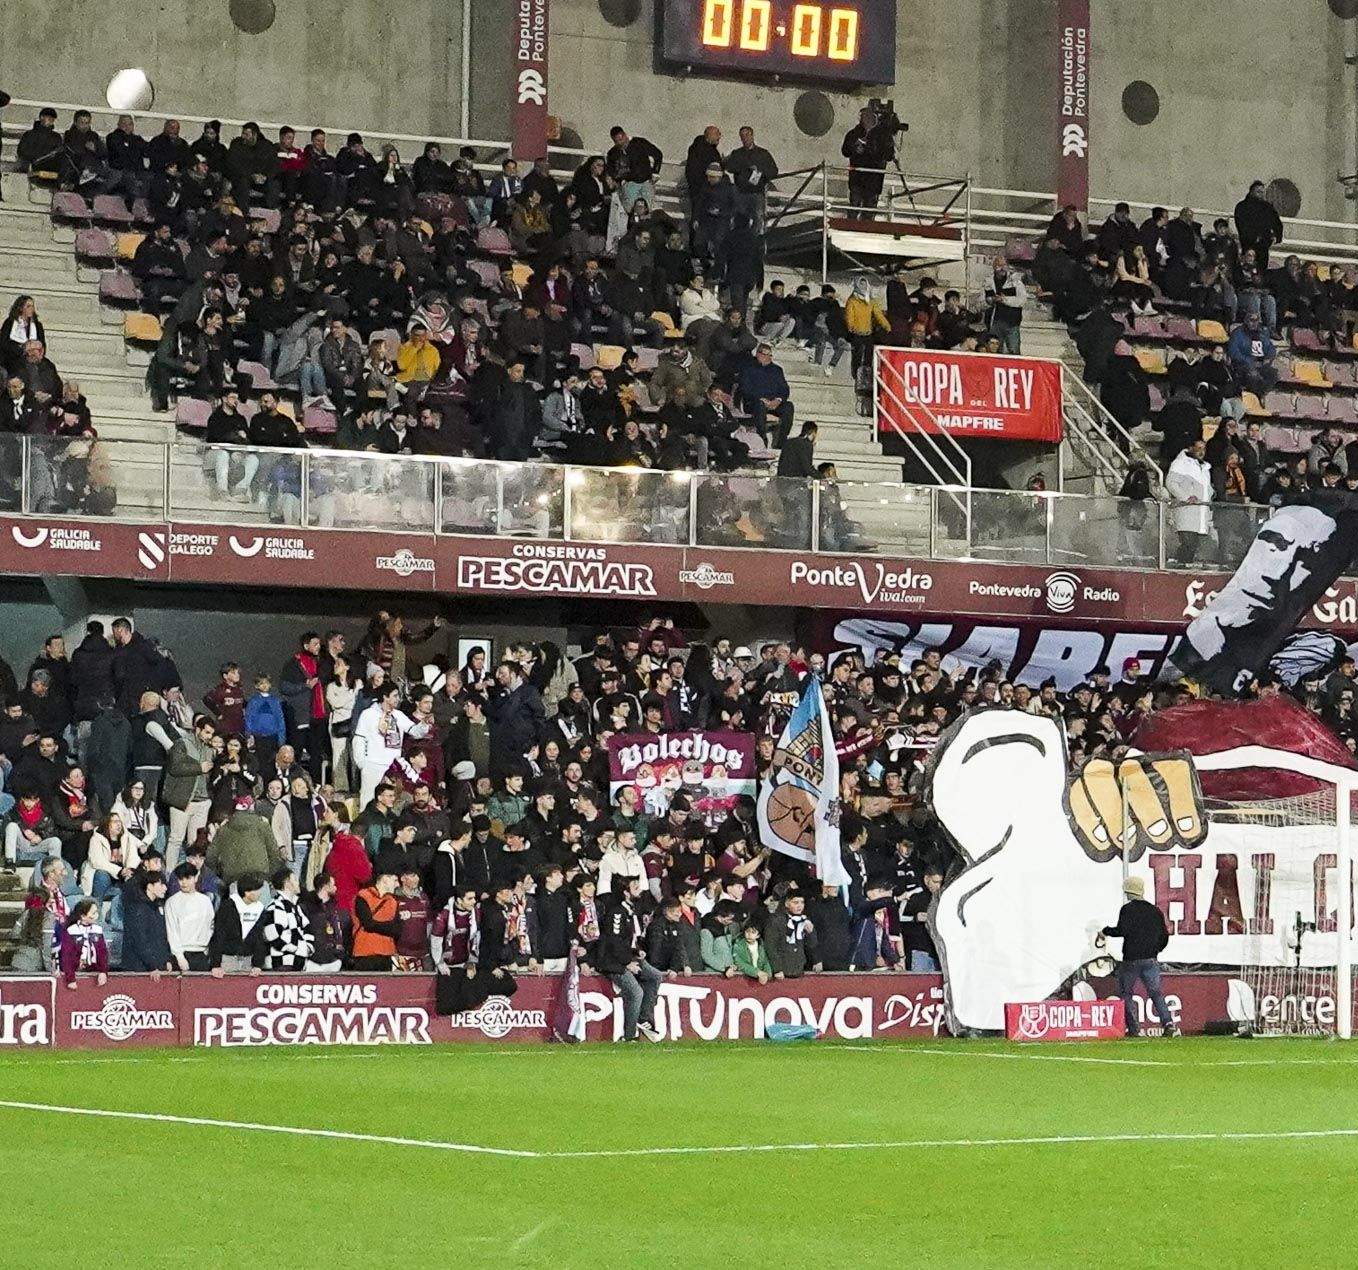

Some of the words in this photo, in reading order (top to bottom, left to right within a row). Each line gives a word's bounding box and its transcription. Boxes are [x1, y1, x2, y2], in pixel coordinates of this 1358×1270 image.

[1061, 27, 1076, 116] Deputación
[1075, 28, 1086, 117] Pontevedra
[903, 361, 964, 406] COPA
[970, 399, 988, 407] DEL
[994, 367, 1034, 410] REY
[935, 414, 1004, 431] MAPFRE
[50, 528, 91, 541] GALICIA
[169, 533, 219, 546] DEPORTE
[265, 536, 304, 549] GALICIA
[50, 538, 101, 551] SAUDABLE
[169, 544, 213, 556] GALEGO
[265, 547, 315, 560] SAUDABLE
[512, 544, 607, 561] CONSERVAS
[377, 557, 435, 571] PESCAMAR
[458, 555, 657, 596] PESCAMAR
[969, 581, 1042, 598] Pontevedra
[1083, 587, 1120, 602] Radio
[618, 733, 744, 774] Bolechos
[1148, 854, 1275, 936] HAI
[256, 985, 377, 1004] CONSERVAS
[1050, 1006, 1081, 1028] COPA
[1091, 1006, 1114, 1027] REY
[1261, 995, 1336, 1023] ence
[71, 1011, 174, 1029] PESCAMAR
[194, 1007, 432, 1046] PESCAMAR
[452, 1010, 546, 1028] PESCAMAR
